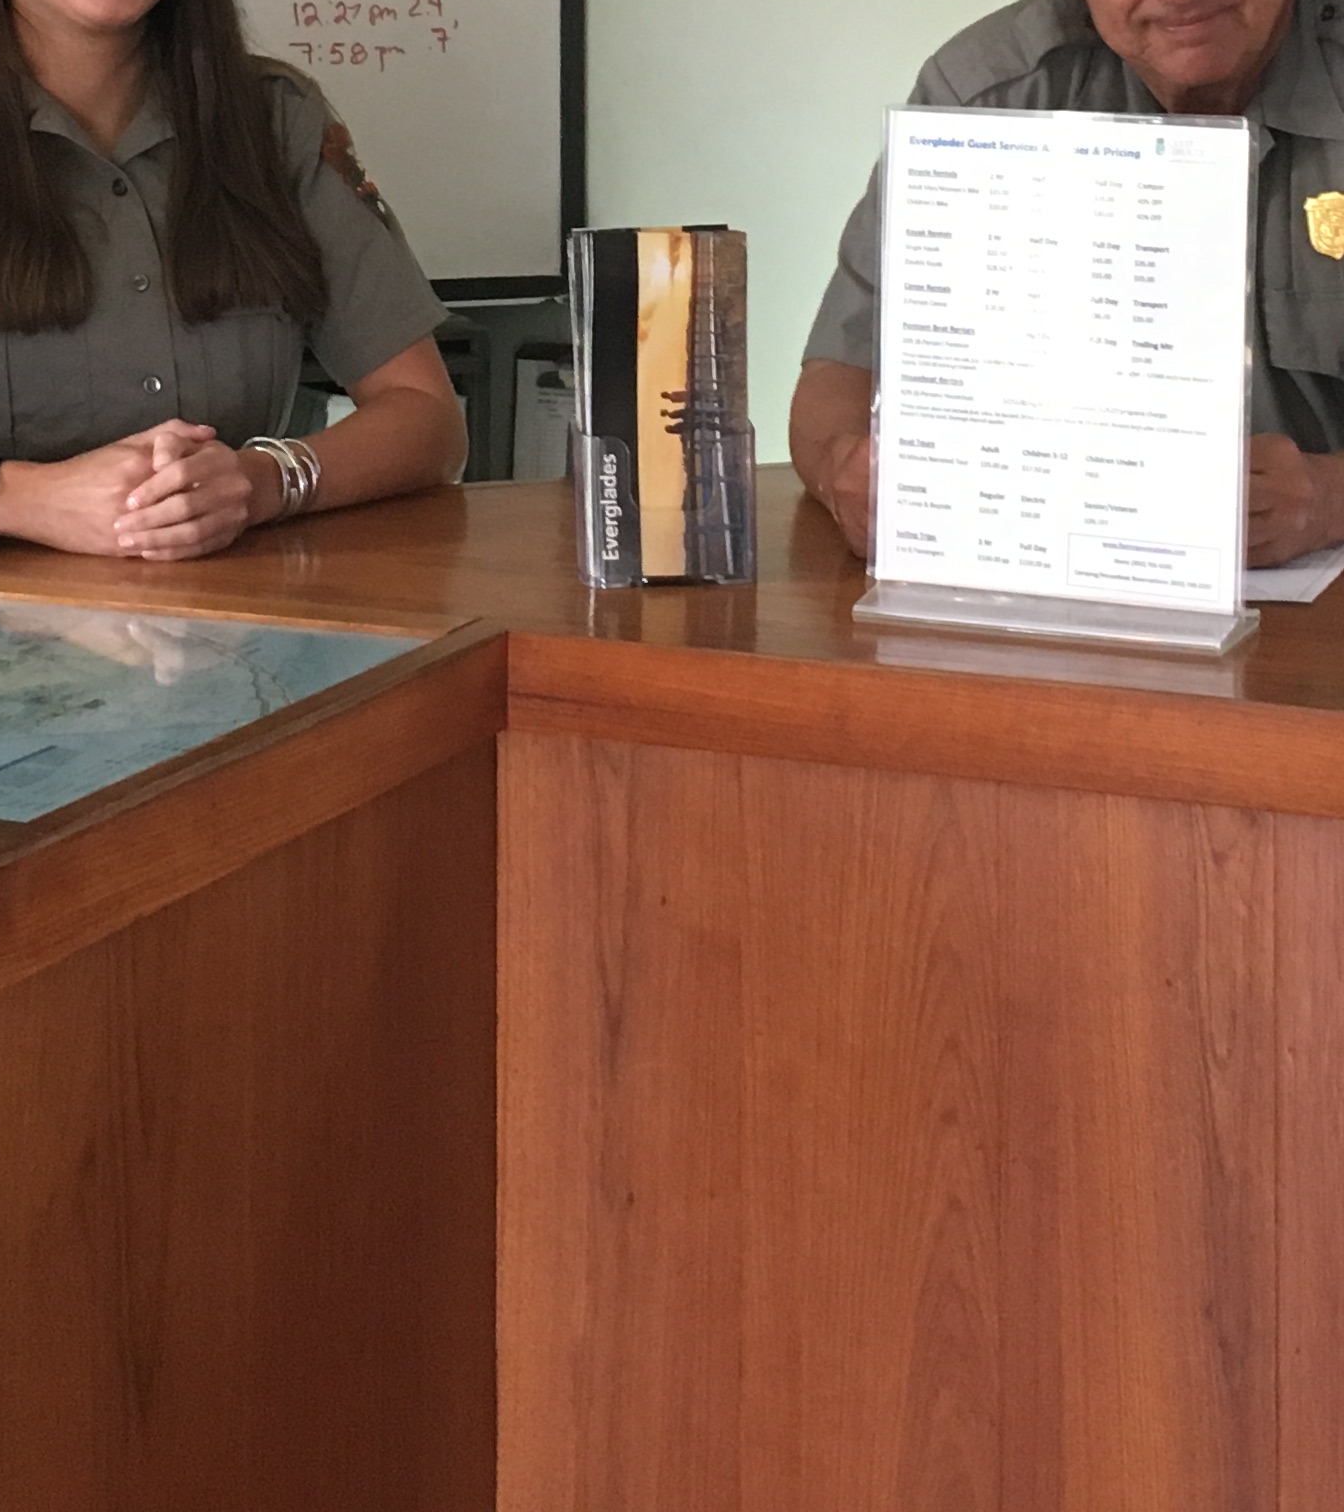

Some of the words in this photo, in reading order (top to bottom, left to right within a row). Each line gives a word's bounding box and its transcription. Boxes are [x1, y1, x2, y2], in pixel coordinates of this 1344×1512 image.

[368, 2, 398, 28] pm
[288, 41, 369, 66] 7:58
[373, 43, 406, 73] pm
[909, 135, 965, 151] Everglades
[967, 138, 997, 151] Guest
[999, 140, 1039, 153] Services
[1103, 147, 1142, 160] Pricing
[600, 452, 622, 563] Everglades
